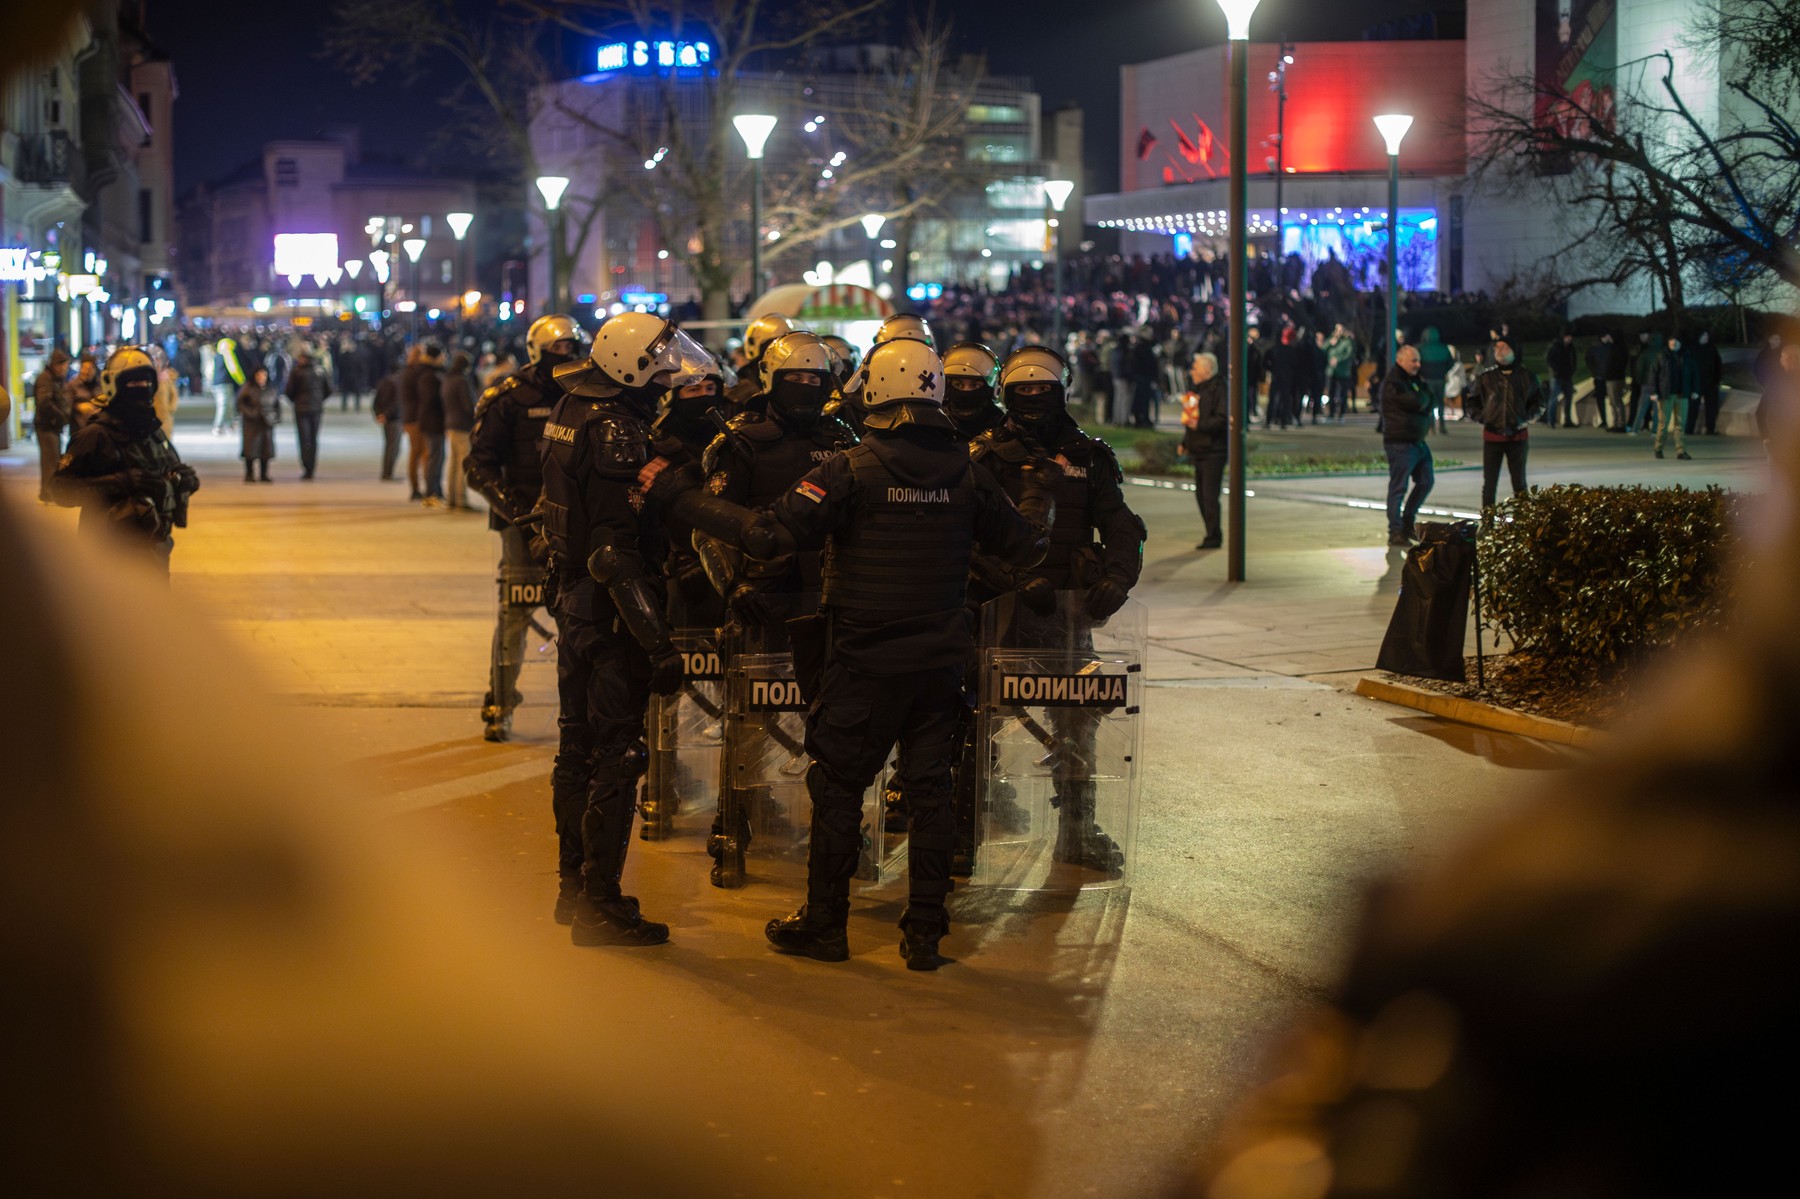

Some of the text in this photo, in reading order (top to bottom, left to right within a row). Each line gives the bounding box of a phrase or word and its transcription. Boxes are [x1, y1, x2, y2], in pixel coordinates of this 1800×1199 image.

[887, 488, 950, 503] ПОЛИЦИЈА
[681, 653, 724, 675] ПОЛ
[752, 682, 807, 705] ПОЛ
[1003, 676, 1124, 704] ПОЛИЦИЈА
